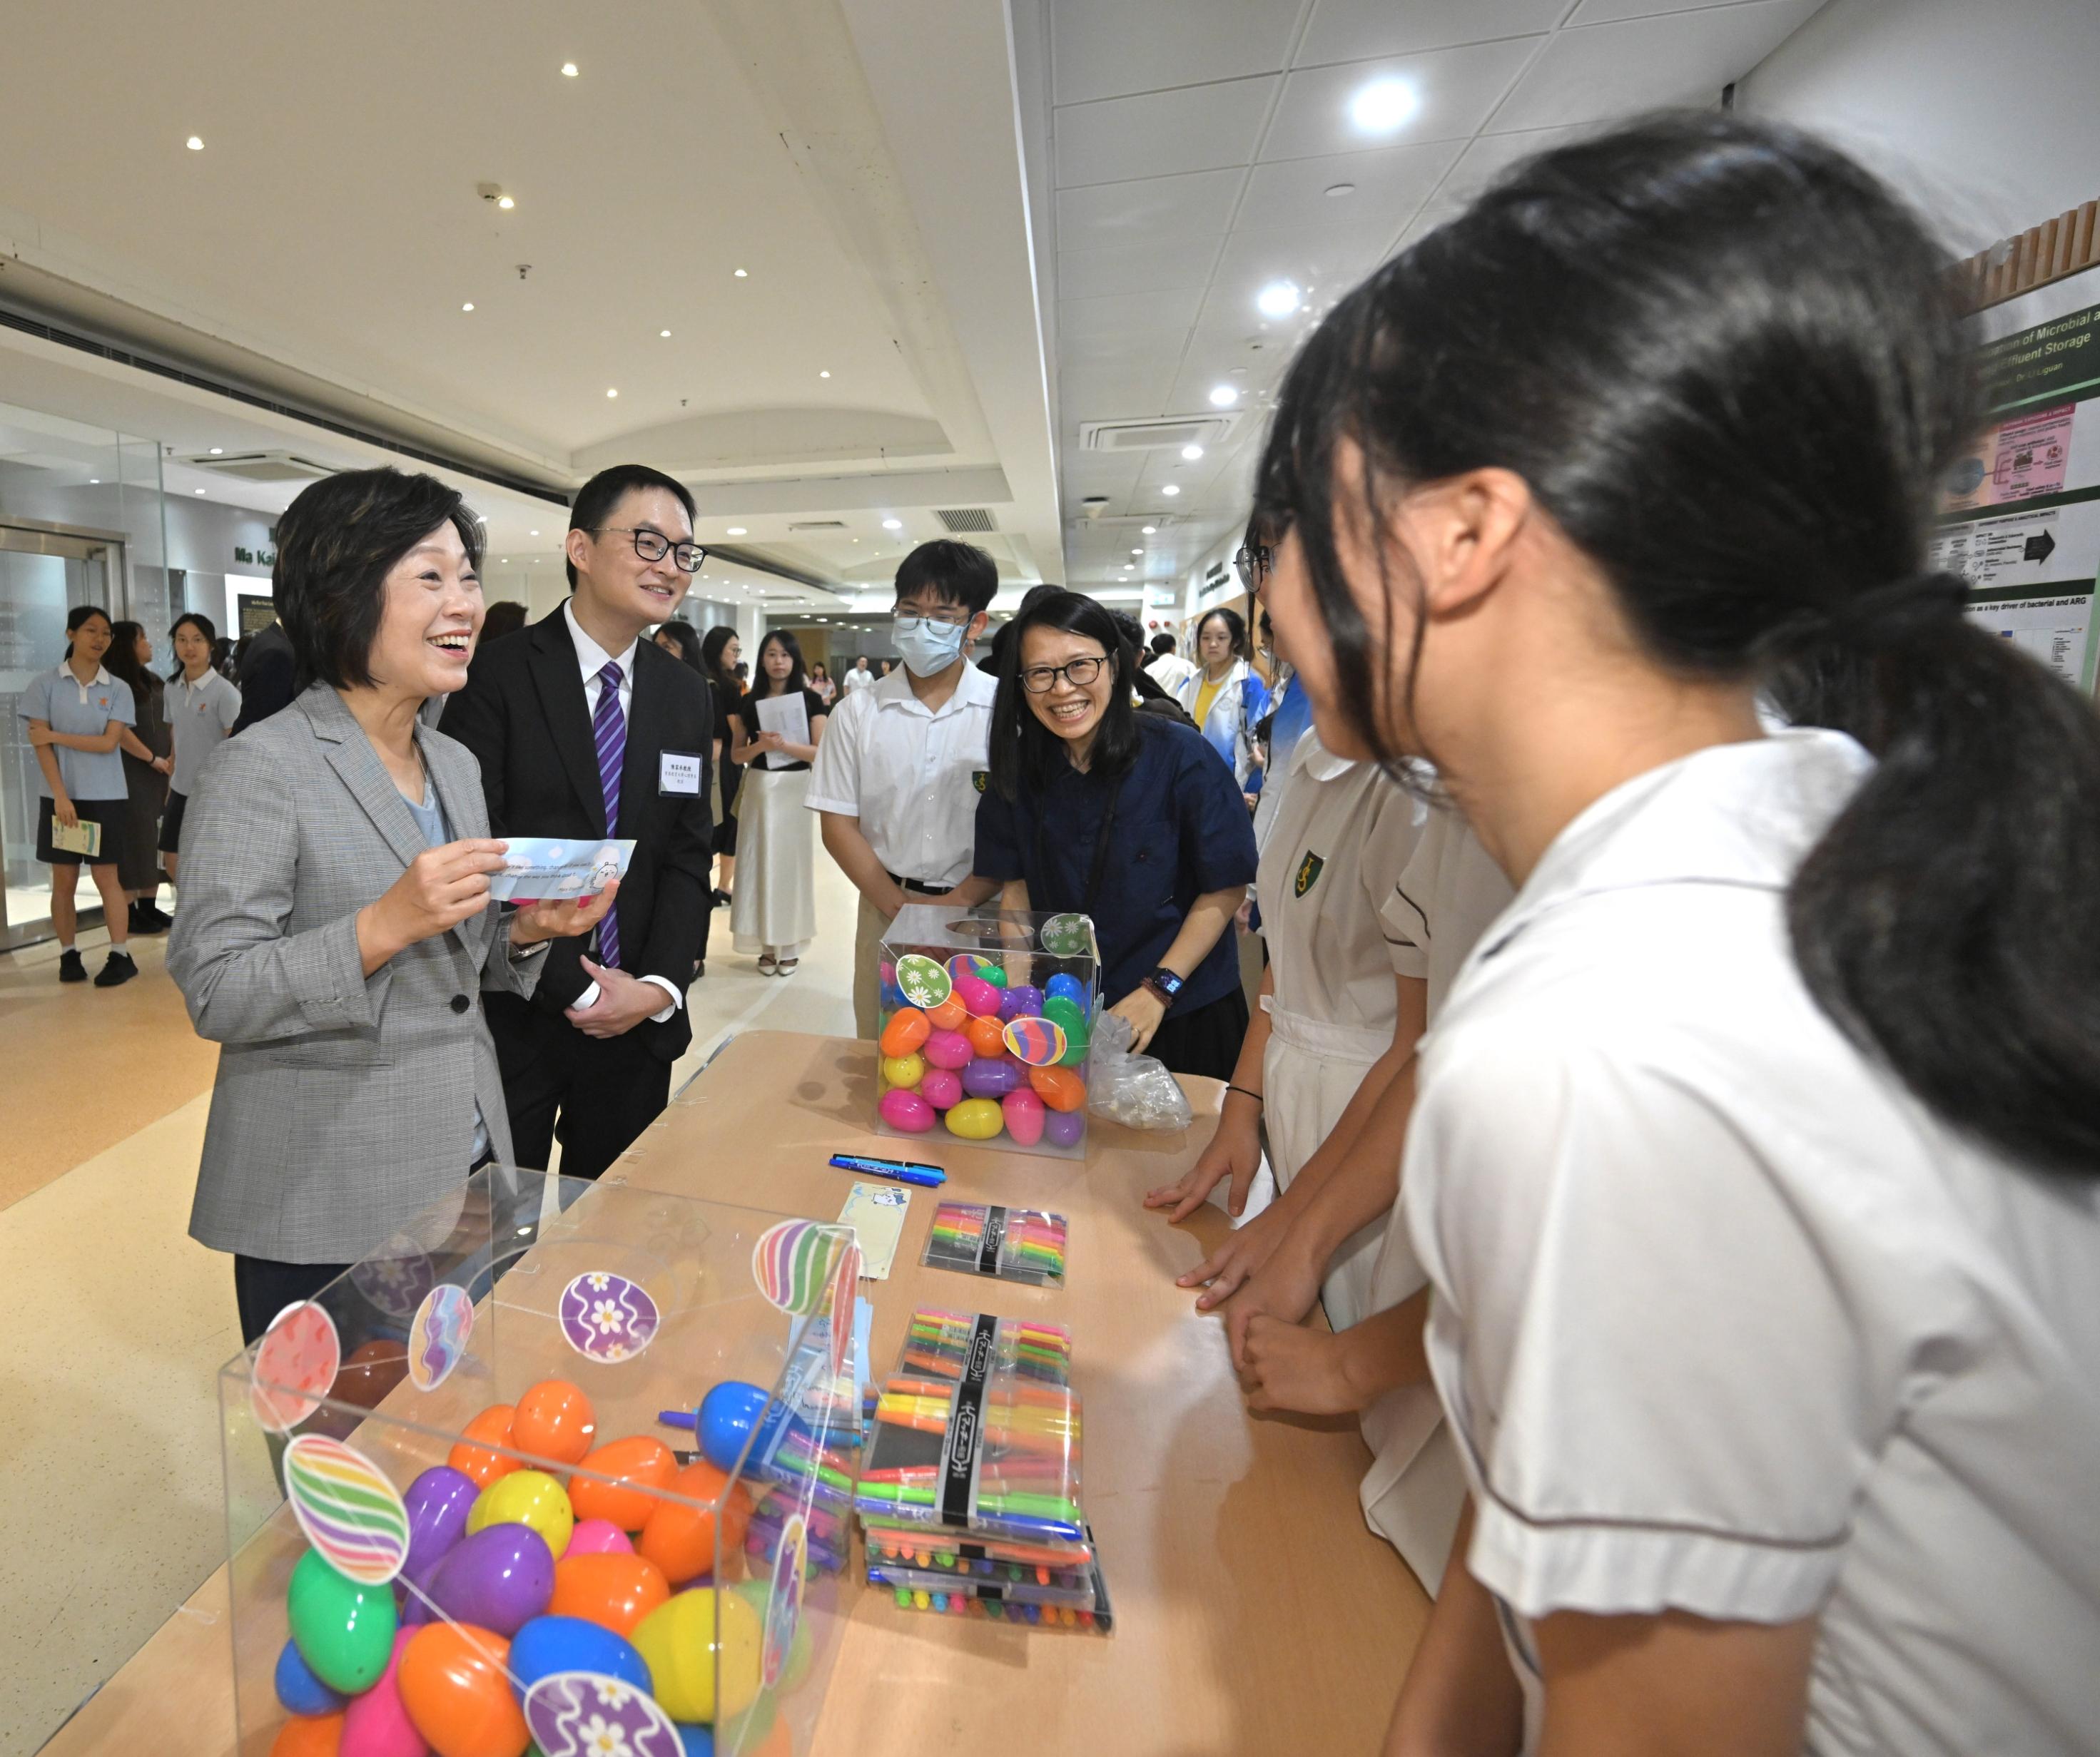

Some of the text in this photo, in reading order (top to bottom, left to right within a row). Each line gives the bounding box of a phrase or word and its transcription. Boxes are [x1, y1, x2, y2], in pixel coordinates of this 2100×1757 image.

[2022, 331, 2034, 345] of
[2036, 312, 2090, 340] Microbial
[2045, 332, 2091, 355] Storage
[235, 546, 253, 564] Ma
[2001, 603, 2019, 611] driver
[2027, 599, 2054, 608] bacterial
[2069, 596, 2087, 606] ARG
